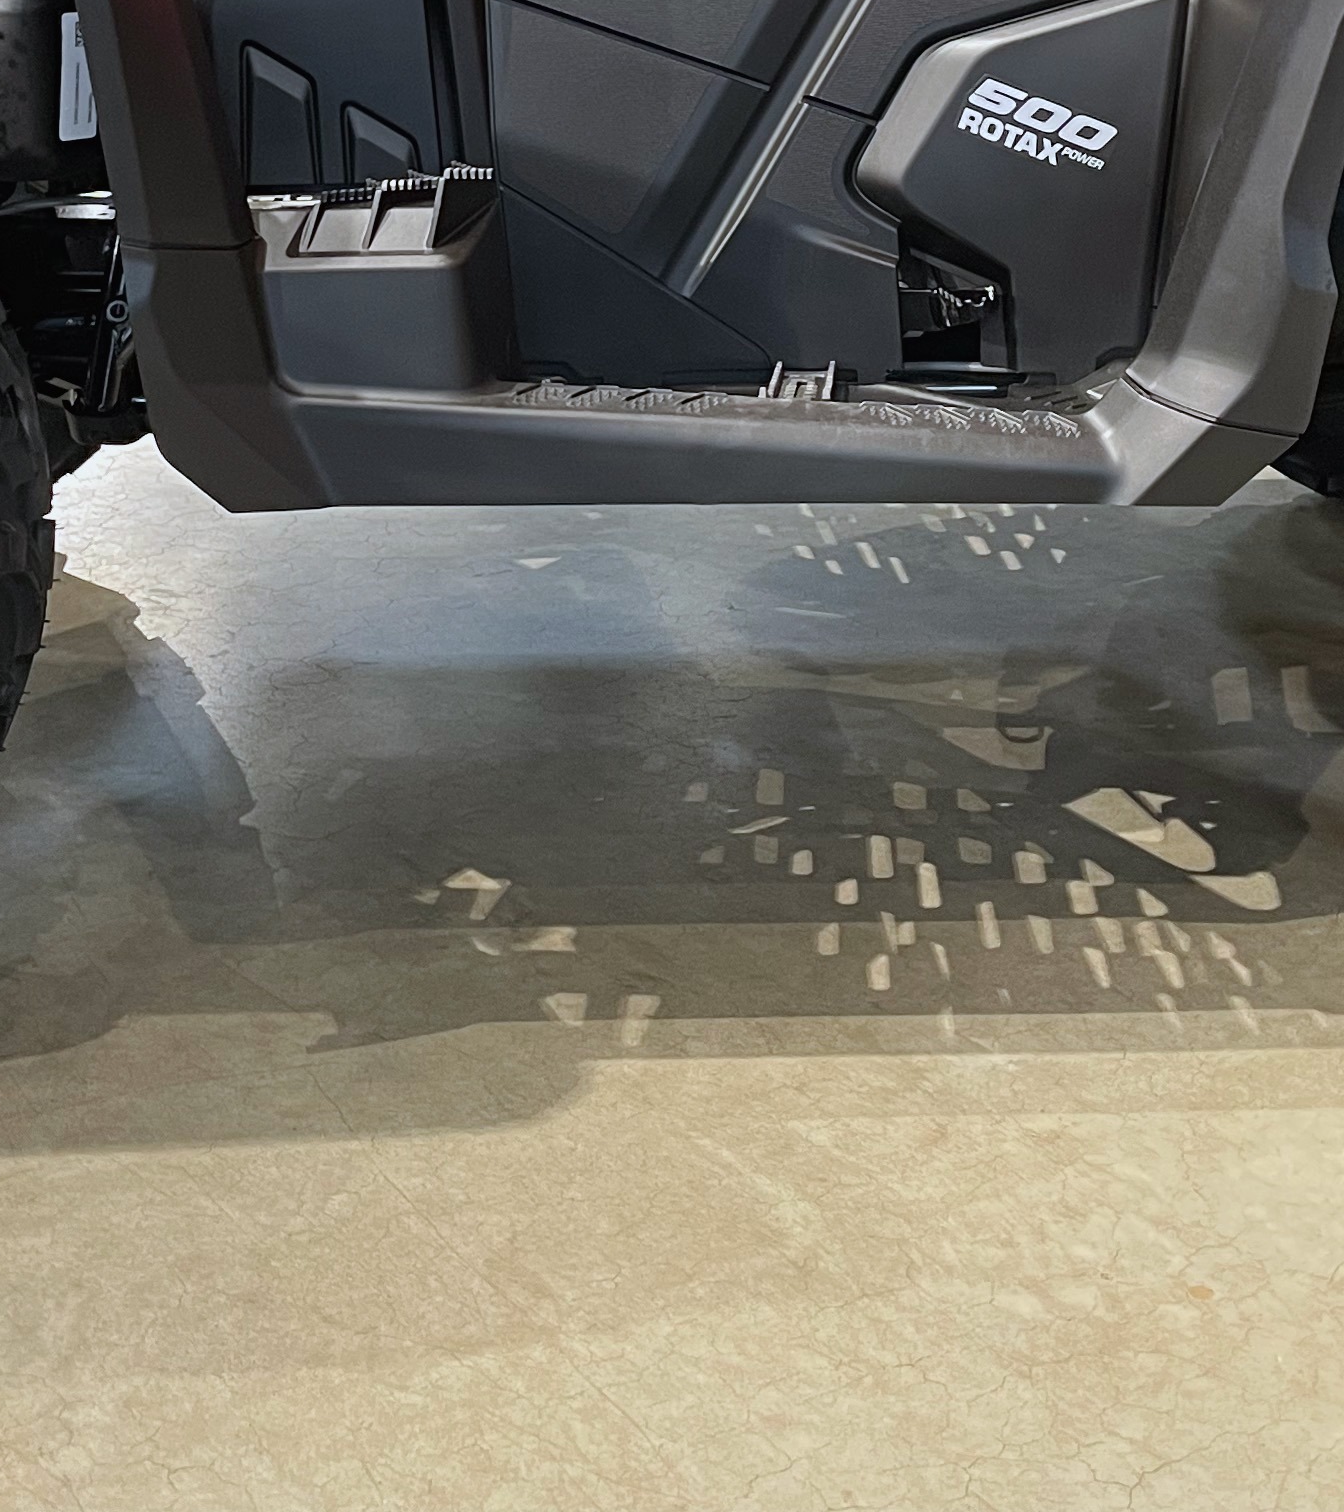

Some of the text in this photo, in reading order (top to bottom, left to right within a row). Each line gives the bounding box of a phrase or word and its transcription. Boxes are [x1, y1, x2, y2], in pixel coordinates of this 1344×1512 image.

[957, 106, 1106, 171] ROTAX POWER
[967, 78, 1119, 151] 500
